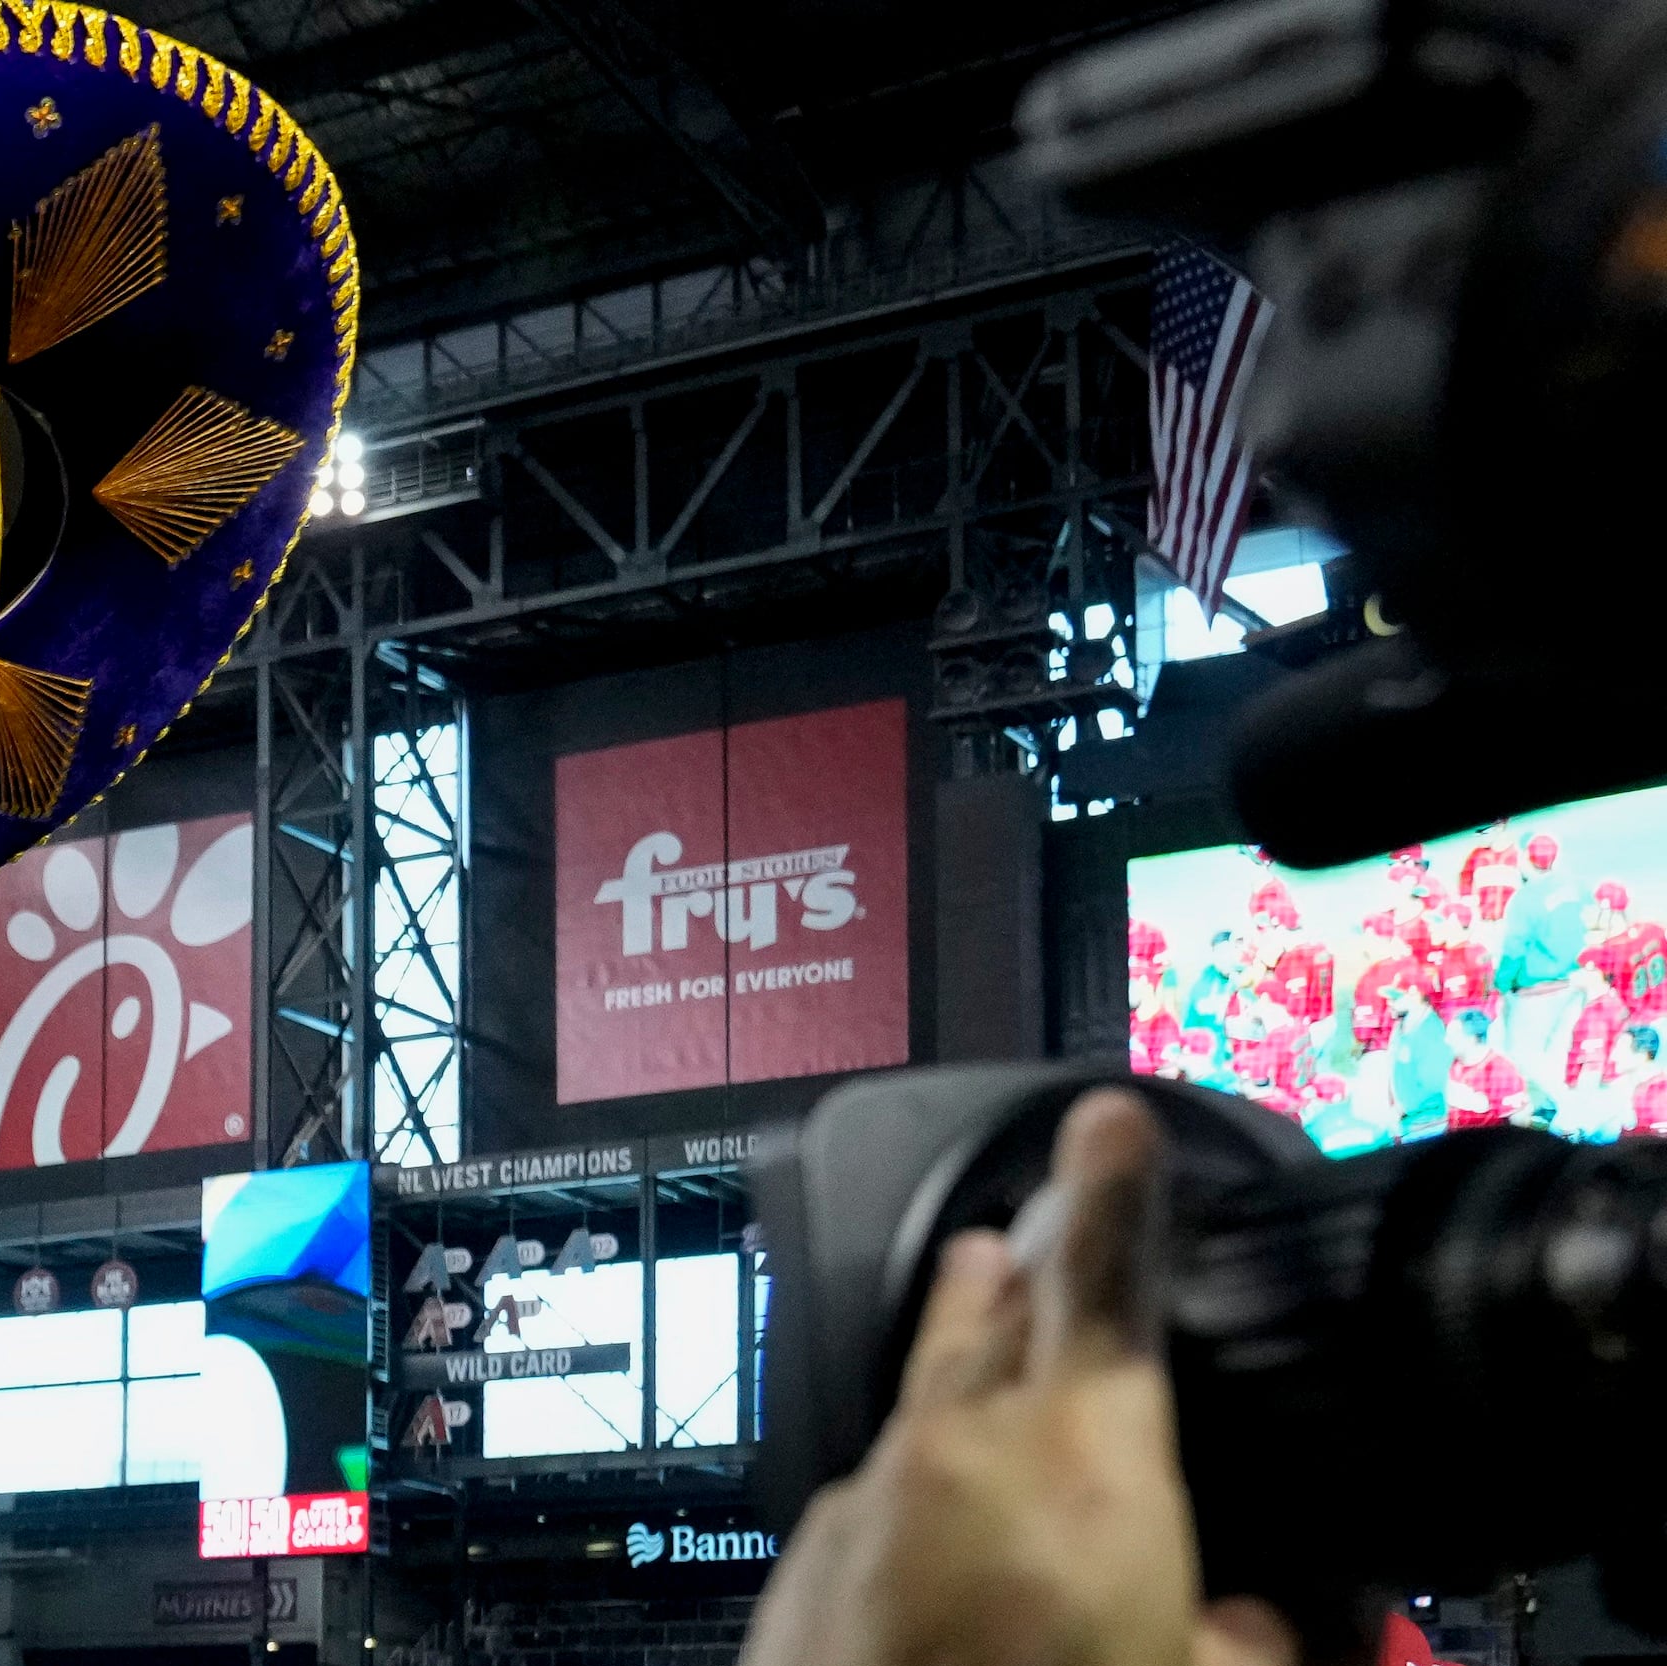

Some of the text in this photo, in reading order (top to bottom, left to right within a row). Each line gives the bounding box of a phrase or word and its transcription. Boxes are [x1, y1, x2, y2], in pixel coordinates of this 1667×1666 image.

[740, 849, 840, 882] STORES
[605, 957, 855, 1012] FRESH FOR EVERYONE
[396, 1147, 633, 1196] NL WEST CHAMPIONS
[445, 1350, 572, 1384] WILD CARD
